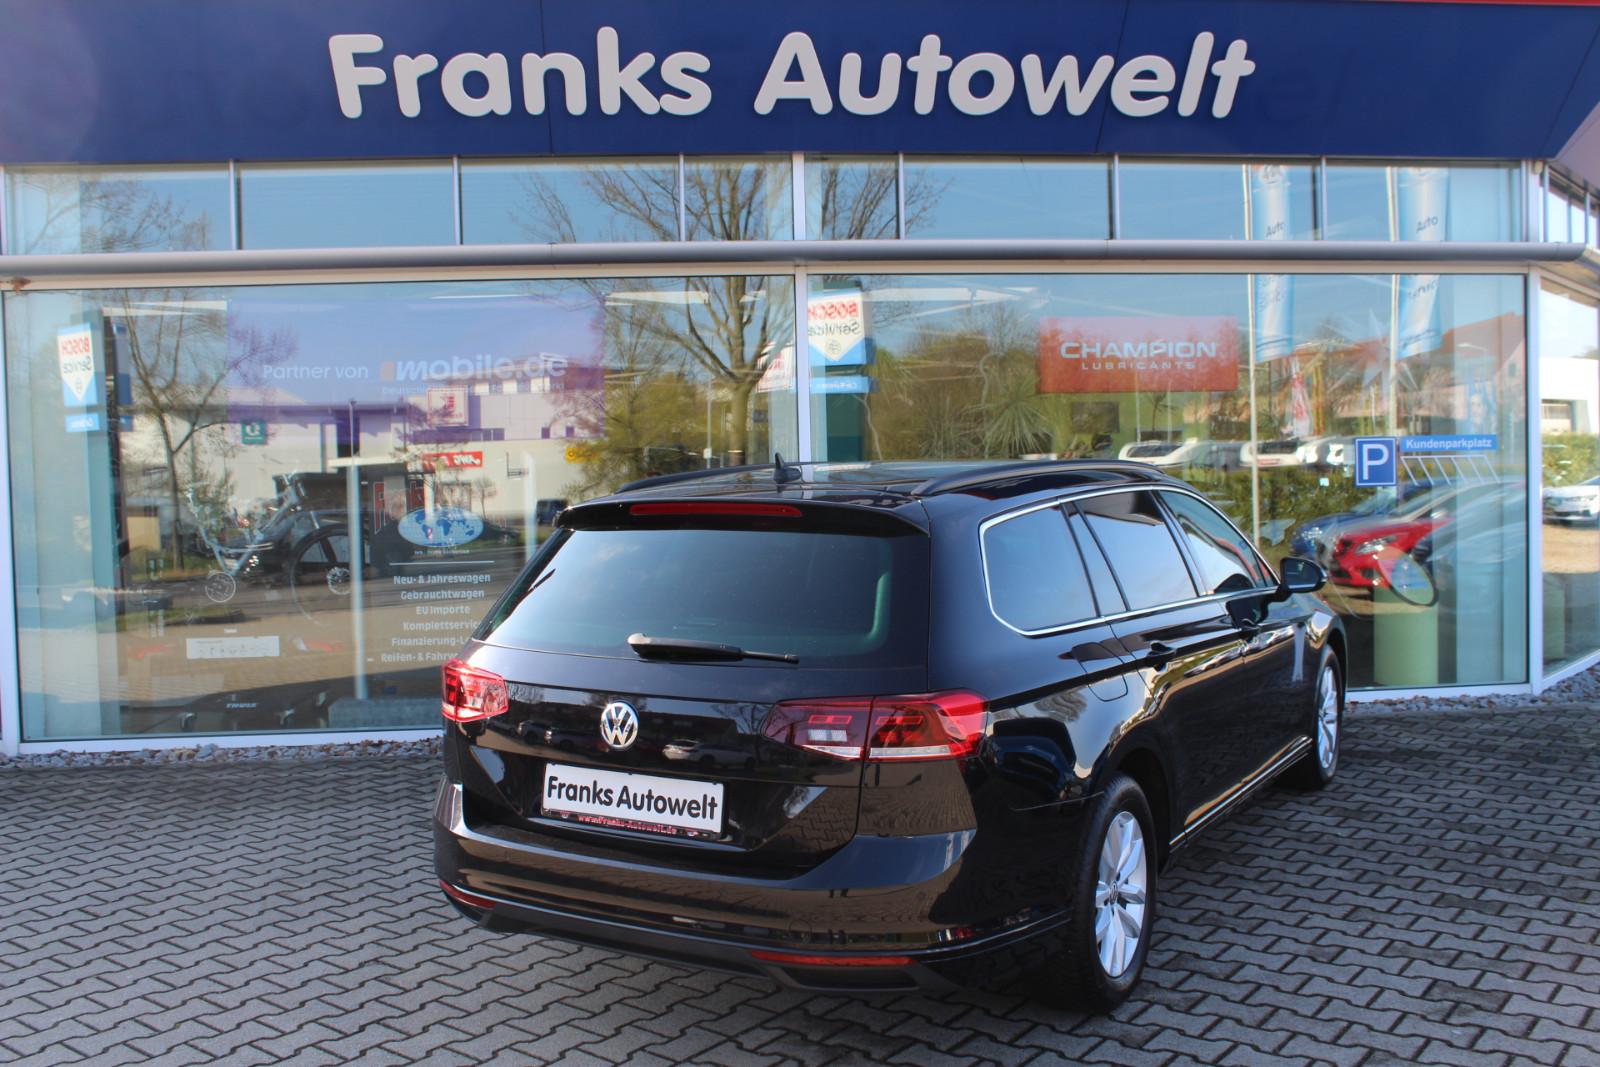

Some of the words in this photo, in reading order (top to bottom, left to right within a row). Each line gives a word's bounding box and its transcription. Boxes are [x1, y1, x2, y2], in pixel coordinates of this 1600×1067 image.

[328, 26, 712, 119] Franks
[754, 31, 1256, 119] Autowelt
[1060, 339, 1217, 358] CHAMPION
[262, 364, 329, 380] Partner
[335, 366, 369, 380] von
[1081, 361, 1195, 371] LUBRICANTS
[1362, 443, 1389, 480] P
[1406, 438, 1493, 450] Kundenparkplatz
[425, 574, 491, 584] Jahreswagen
[400, 589, 485, 600] Gebrauchtwagen
[416, 606, 429, 615] EU
[430, 605, 471, 616] Importe
[403, 620, 480, 632] Komplettservic
[547, 776, 614, 807] Franks
[616, 785, 718, 820] Autowelt
